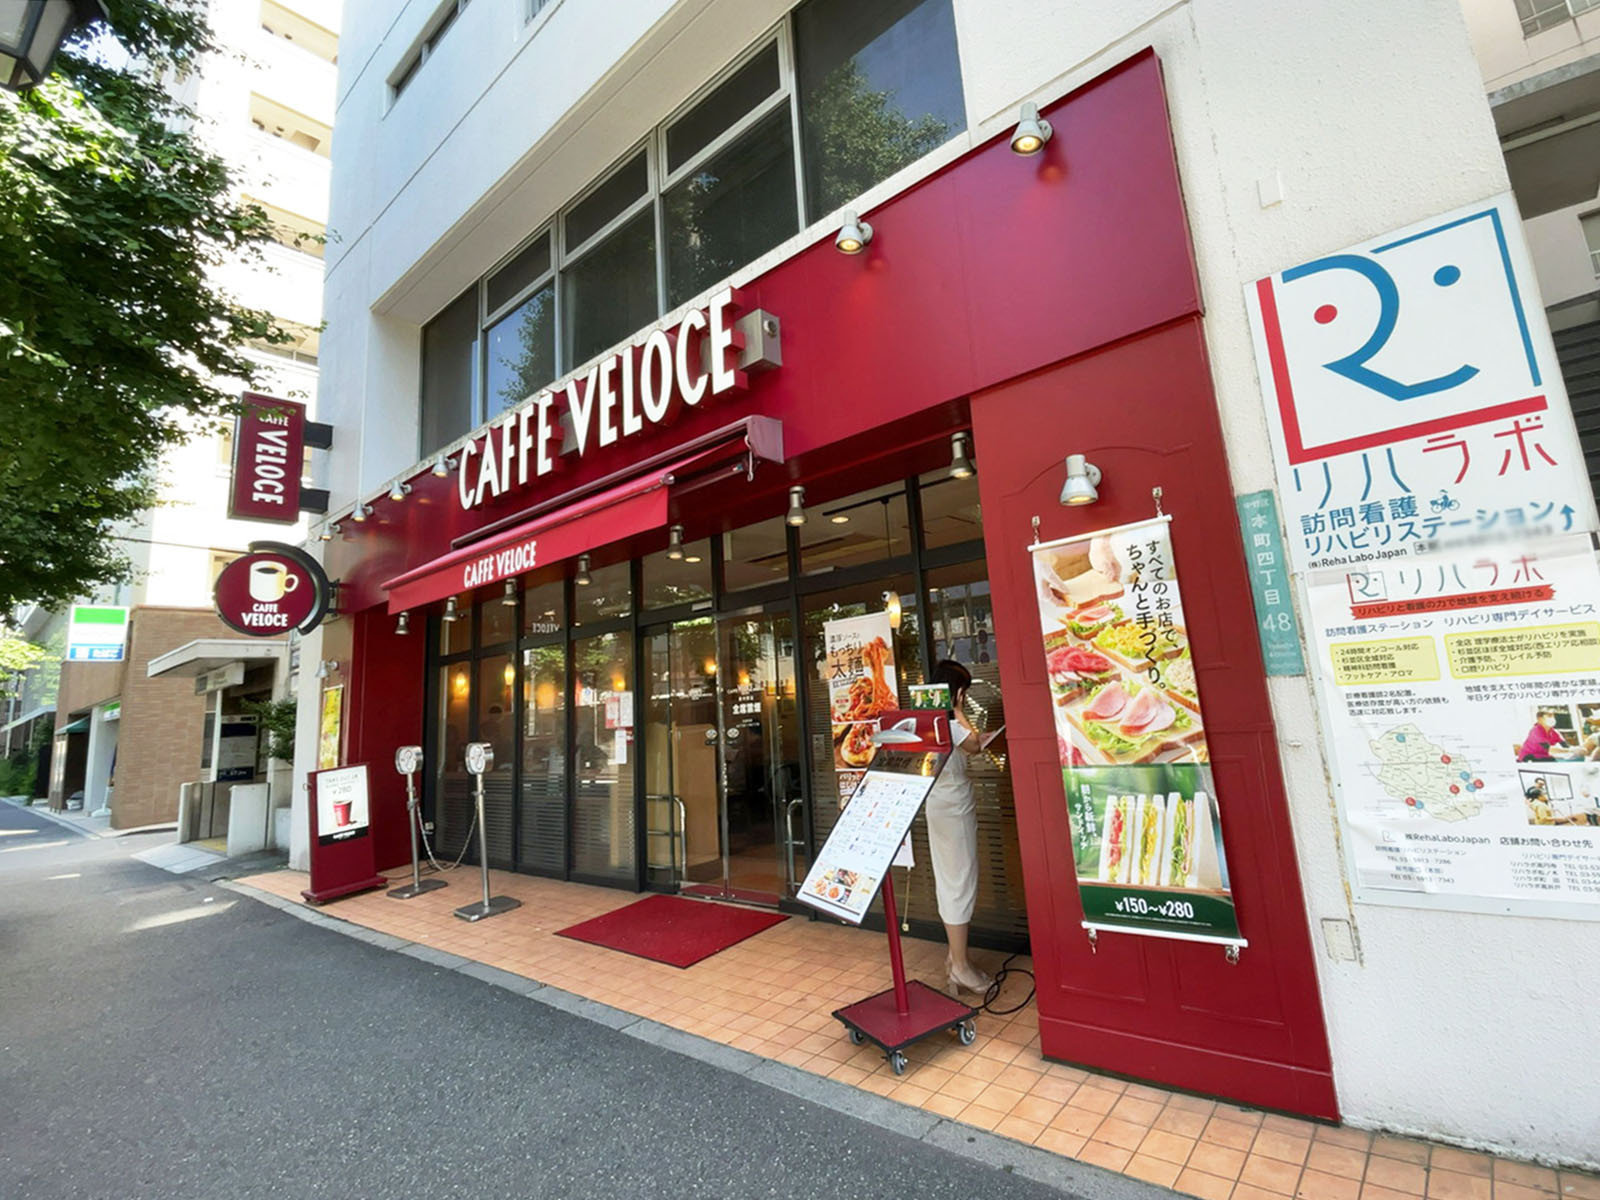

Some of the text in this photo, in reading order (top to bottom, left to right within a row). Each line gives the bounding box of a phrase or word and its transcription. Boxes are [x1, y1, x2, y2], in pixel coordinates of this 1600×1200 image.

[566, 286, 736, 458] VELOCE
[252, 430, 288, 505] VELOCE
[1293, 416, 1558, 509] リハラボ
[1300, 495, 1420, 536] 訪問看護
[1304, 502, 1555, 557] リハビリステーション
[496, 541, 537, 576] VELOCE
[1251, 513, 1280, 605] 本町四丁目
[1399, 555, 1545, 595] リハラボ
[252, 603, 279, 613] CAFFE
[1127, 545, 1166, 689] ちゃんと手づくり。
[1146, 540, 1178, 648] すべてのお店で、
[241, 612, 289, 627] VELOCE
[1263, 612, 1292, 632] 48
[1325, 604, 1597, 638] 訪問看護ステーション リハビリ専門デイサービス
